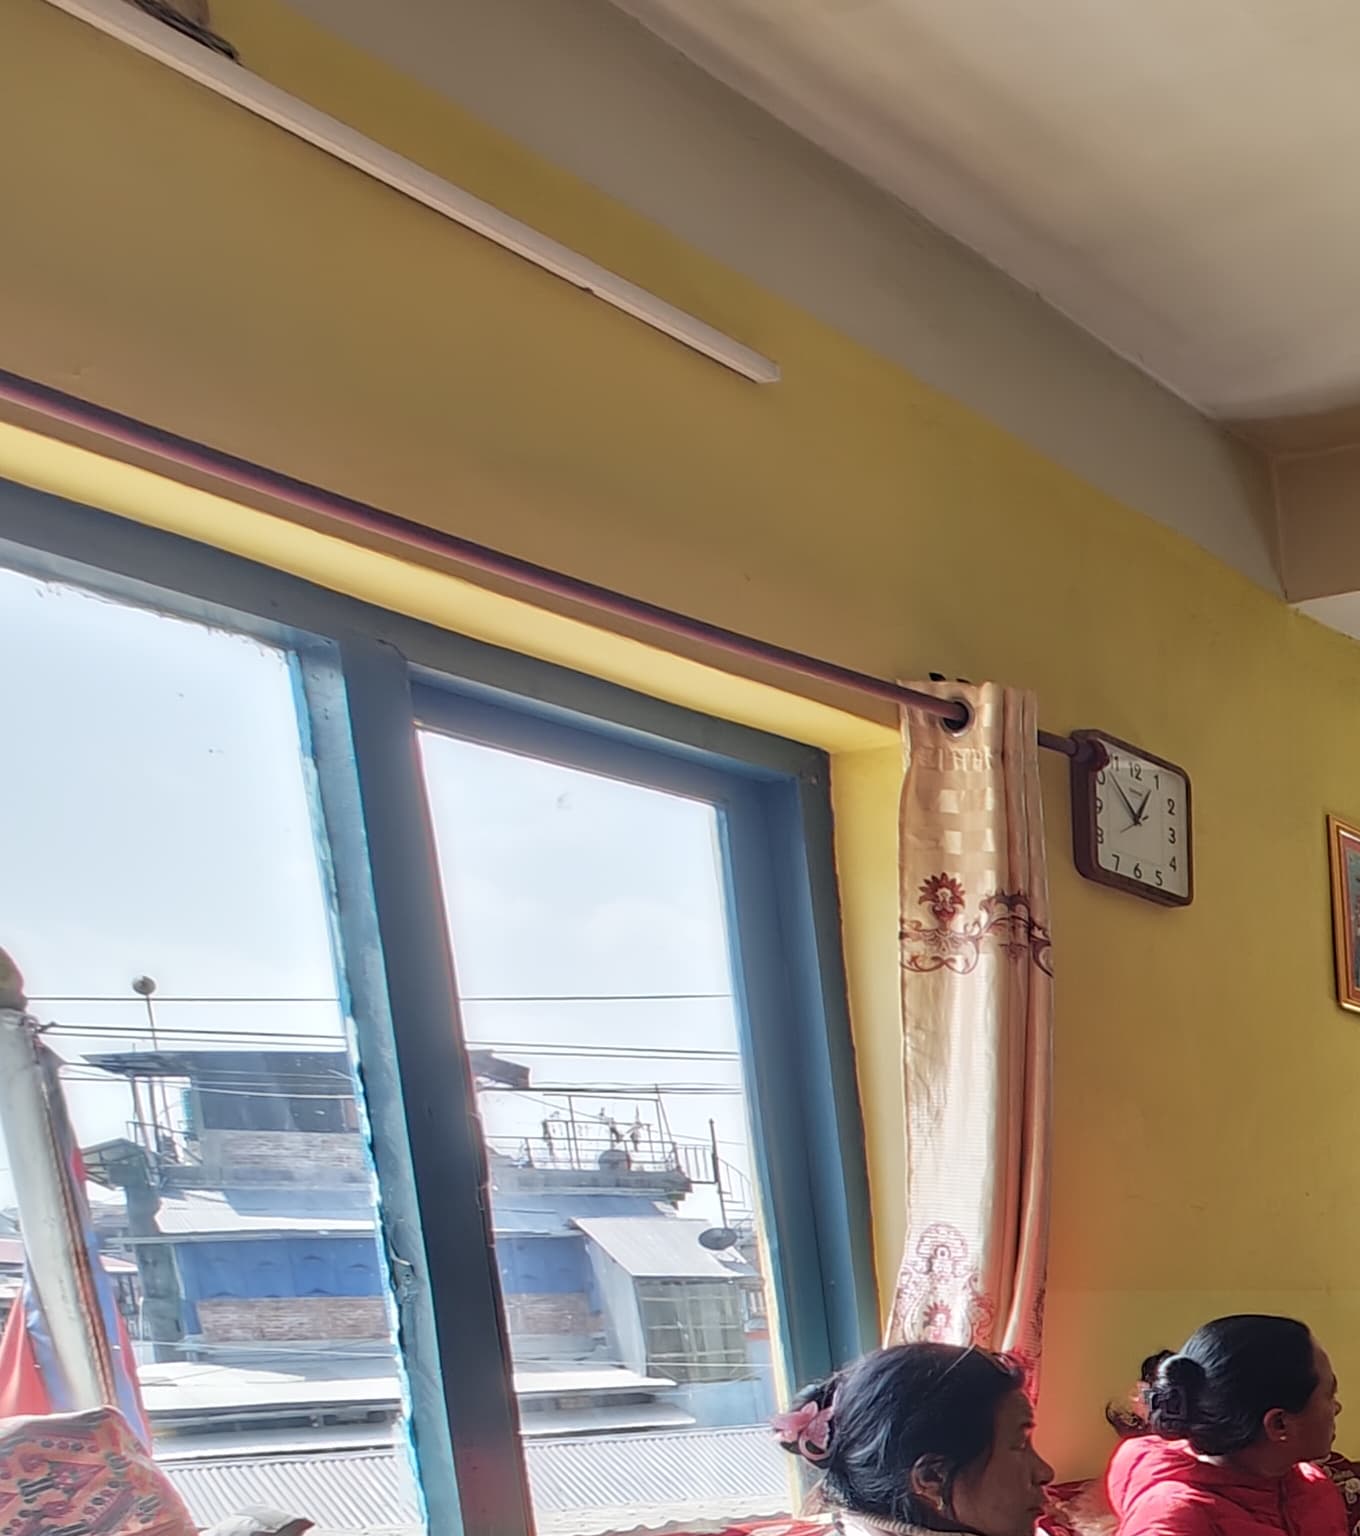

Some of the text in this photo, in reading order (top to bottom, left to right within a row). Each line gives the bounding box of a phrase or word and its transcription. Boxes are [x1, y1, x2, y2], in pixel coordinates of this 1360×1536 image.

[1129, 762, 1143, 781] 12
[1154, 775, 1160, 790] 1
[1167, 798, 1176, 815] 2
[1168, 827, 1177, 844] 3
[1112, 854, 1120, 871] 7
[1169, 856, 1177, 872] 4
[1133, 863, 1142, 879] 6
[1155, 870, 1163, 886] 5
